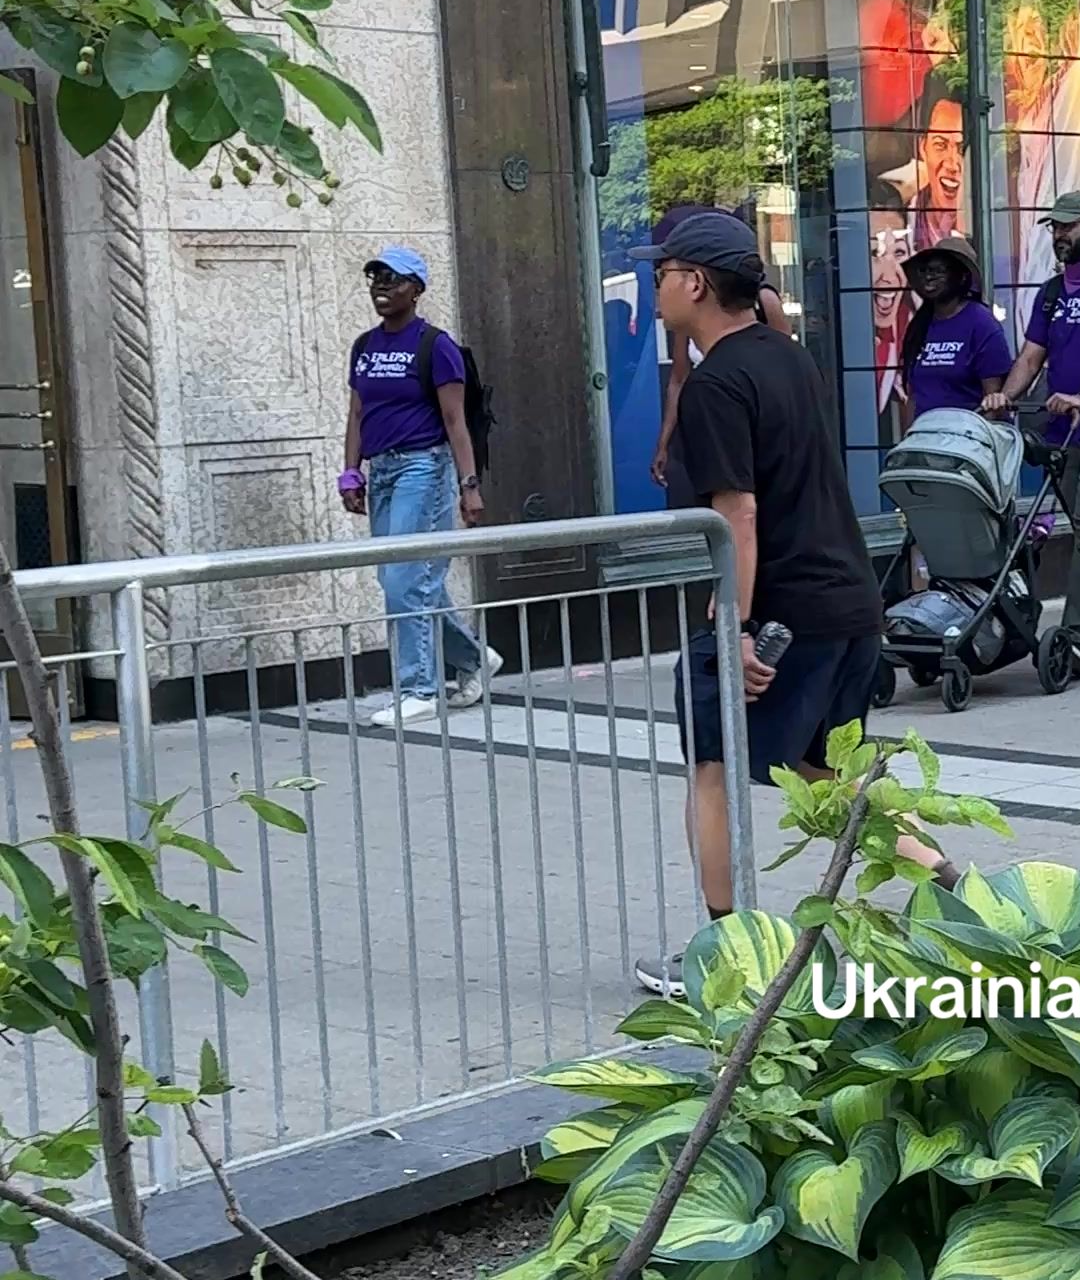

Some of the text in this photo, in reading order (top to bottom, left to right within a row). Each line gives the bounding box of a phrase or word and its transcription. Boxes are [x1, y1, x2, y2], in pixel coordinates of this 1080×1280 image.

[924, 342, 965, 352] EPILEPSY
[371, 352, 415, 363] EPILEPSY
[371, 362, 406, 372] Toronto
